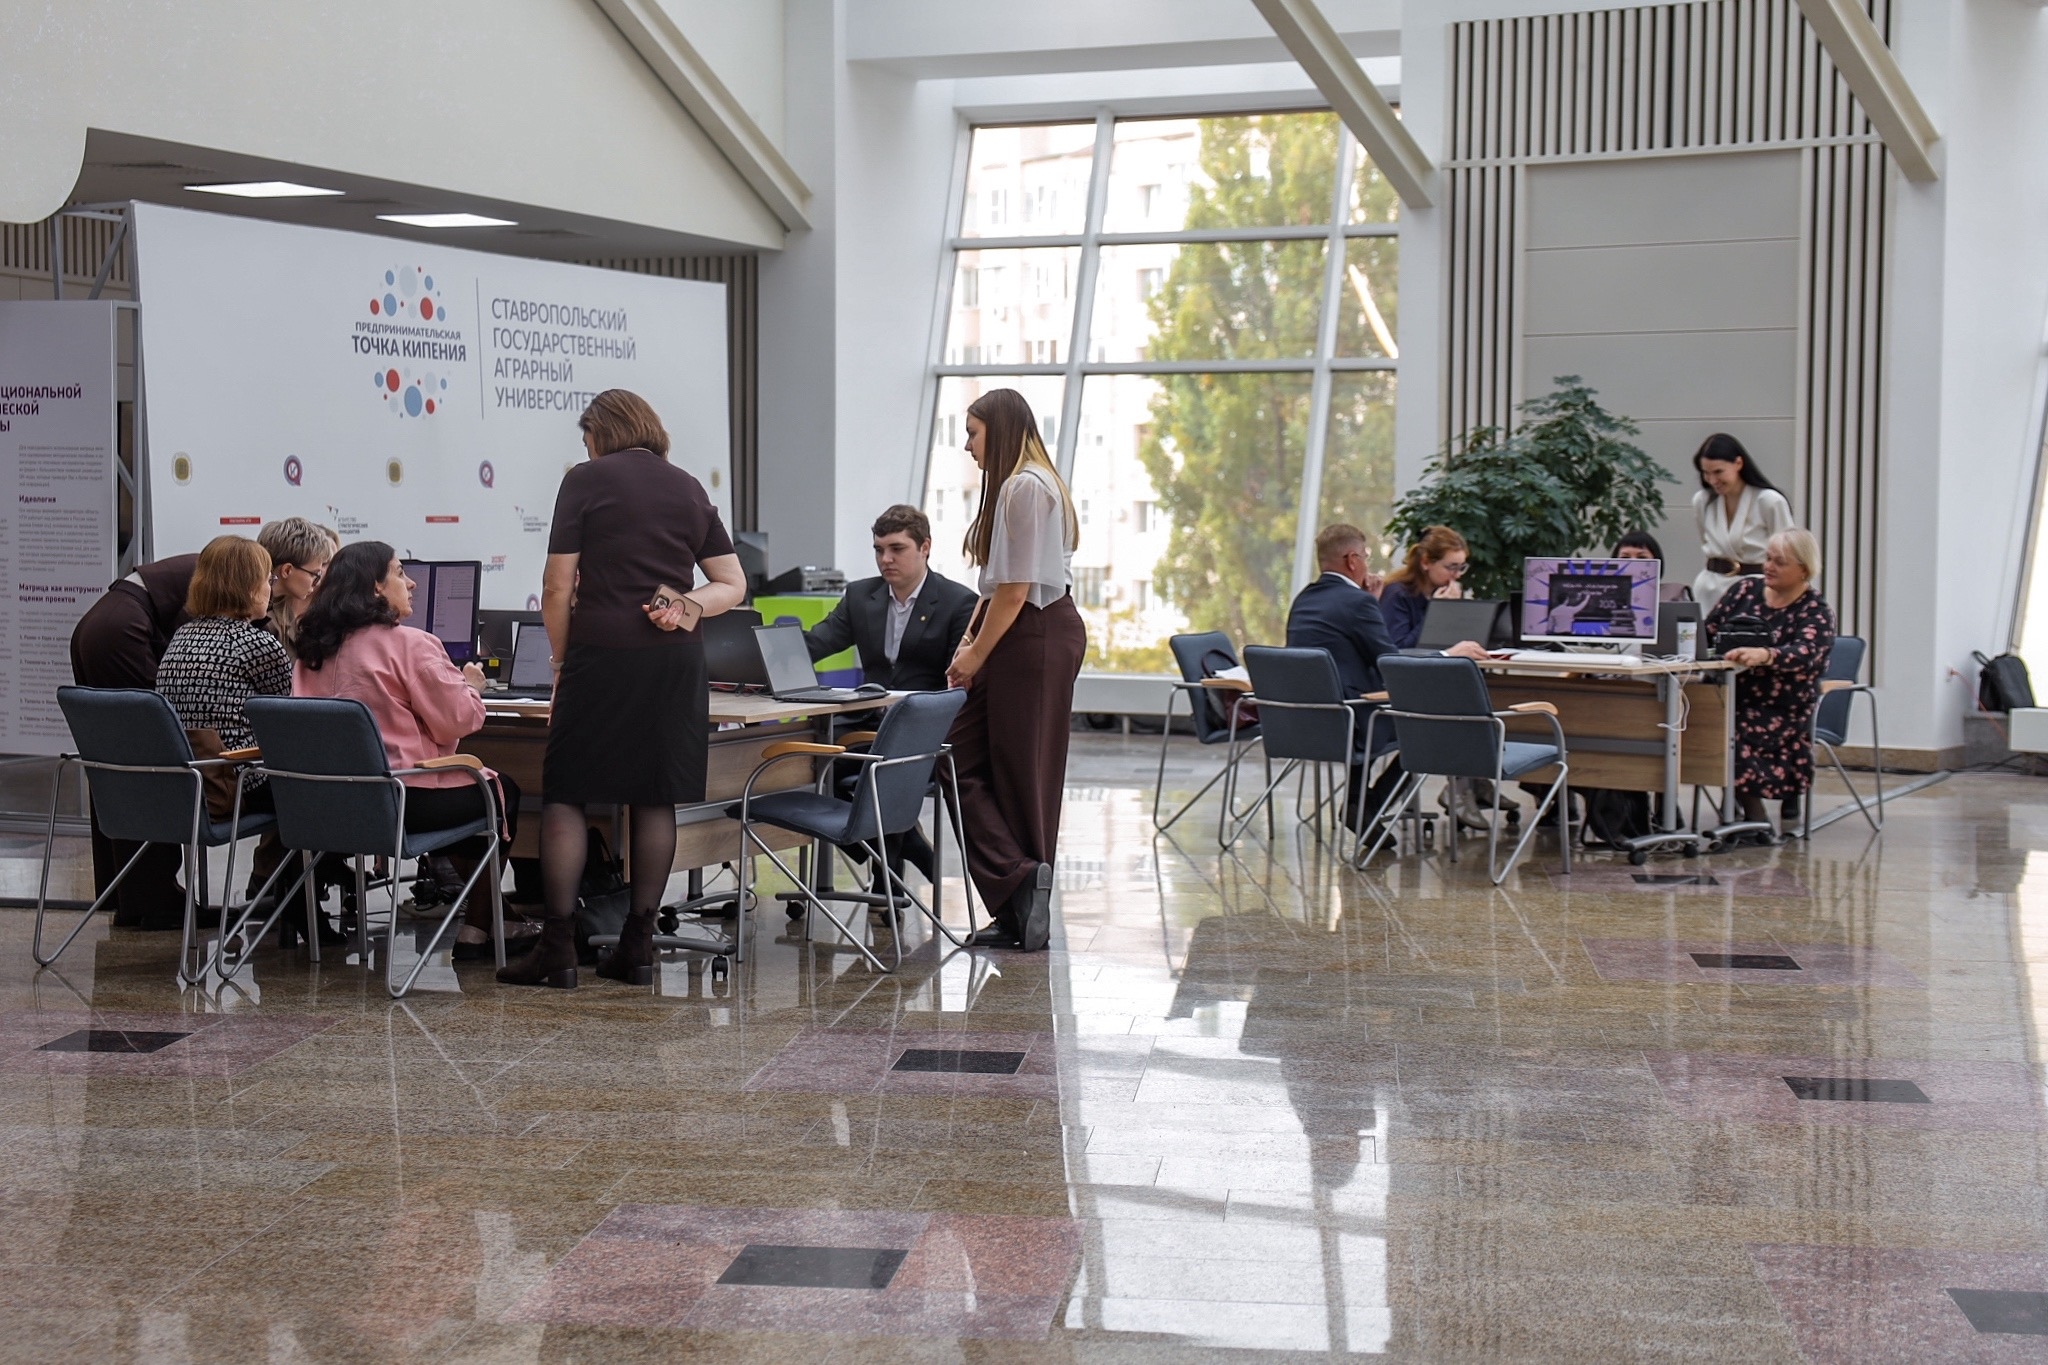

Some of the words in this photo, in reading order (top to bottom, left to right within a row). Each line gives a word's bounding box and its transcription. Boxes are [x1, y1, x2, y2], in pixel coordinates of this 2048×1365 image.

[491, 298, 627, 332] СТАВРОПОЛЬСКИЙ
[355, 321, 461, 341] ПРЕДПРИНИМАТЕЛЬСКАЯ
[351, 335, 399, 356] ТОЧКА
[402, 340, 466, 362] КИПЕНИЯ
[493, 327, 637, 360] ГОСУДАРСТВЕННЫЙ
[494, 357, 573, 383] АГРАРНЫЙ
[1, 383, 82, 401] ЦИОНАЛЬНОЙ
[19, 583, 48, 593] Матрица
[64, 586, 103, 594] инструмент
[19, 595, 43, 603] оценки
